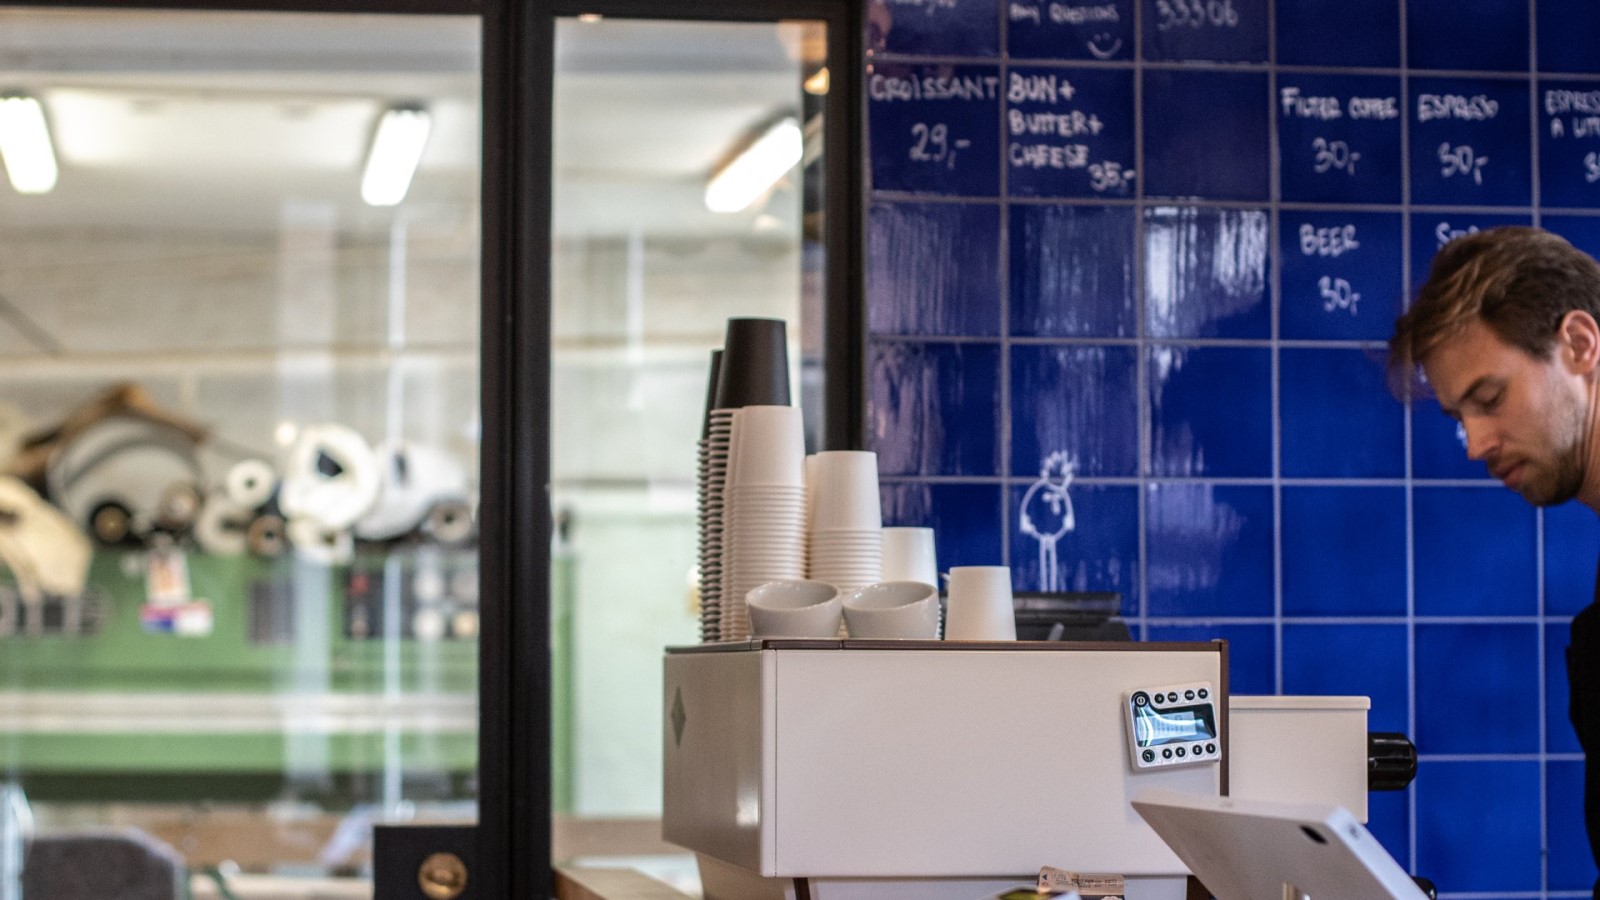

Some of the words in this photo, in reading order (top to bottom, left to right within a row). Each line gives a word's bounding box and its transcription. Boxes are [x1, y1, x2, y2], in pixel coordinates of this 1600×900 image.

[869, 74, 1000, 101] CROISSANT
[1417, 93, 1500, 122] ESPRESSO
[1008, 142, 1090, 170] CHEESE
[1299, 222, 1360, 257] BEER
